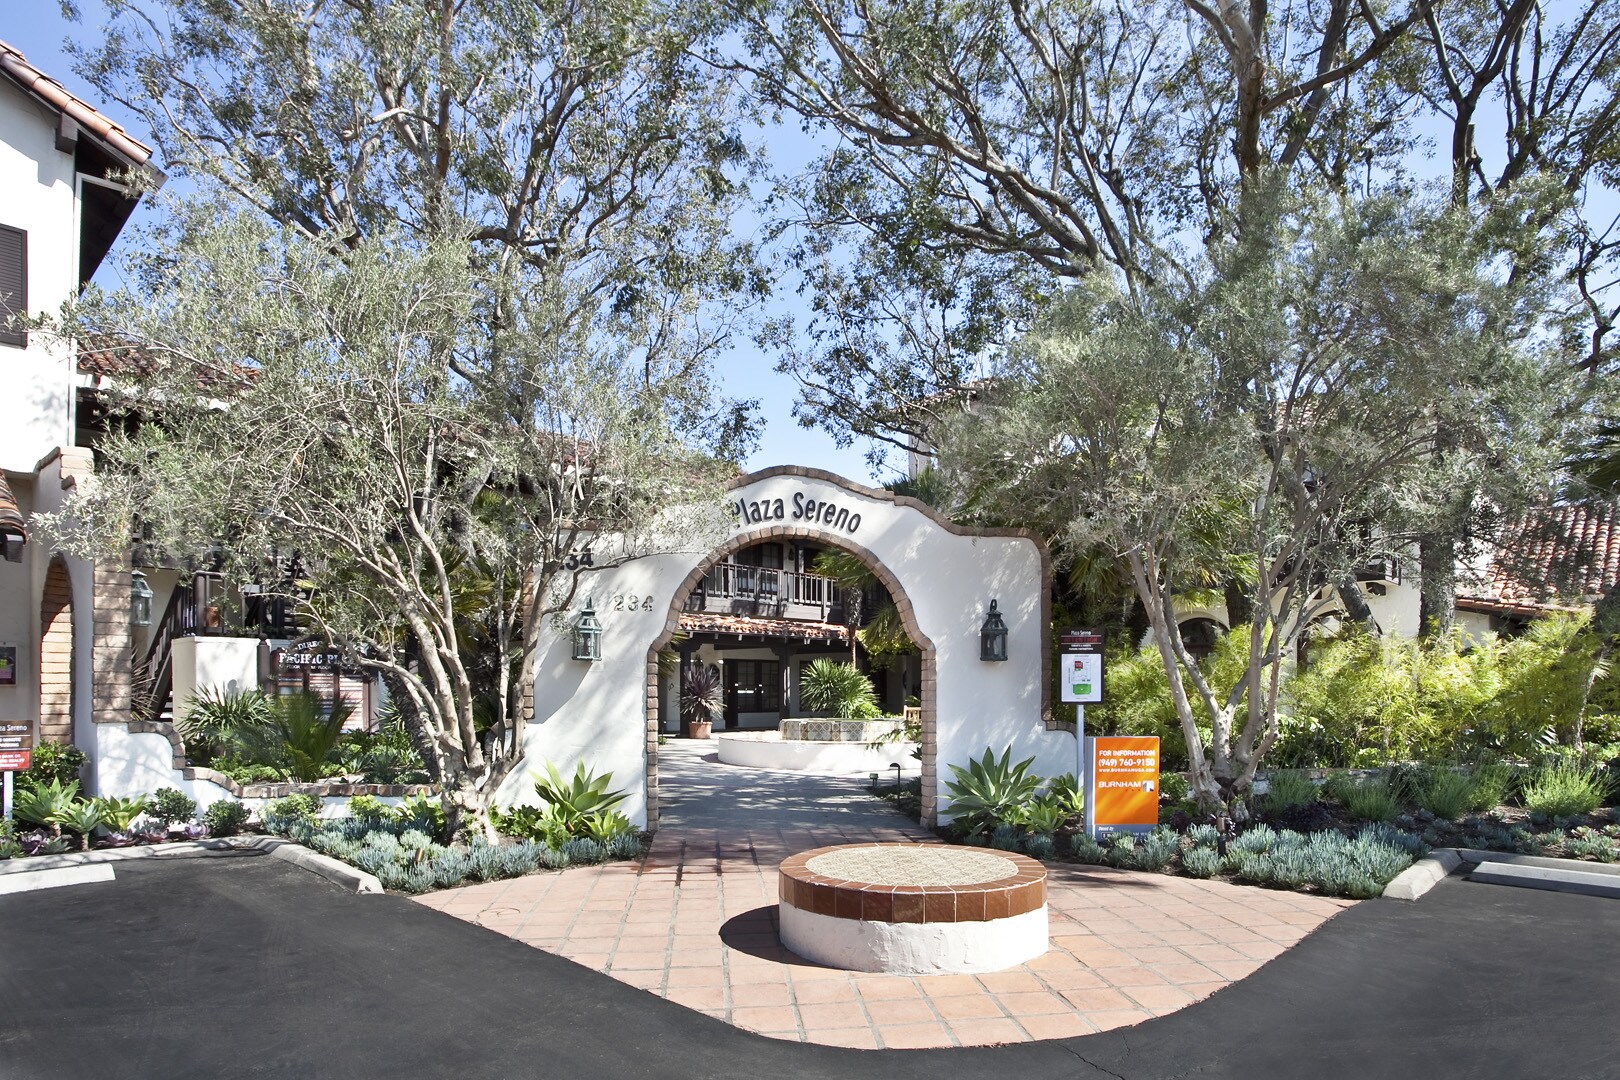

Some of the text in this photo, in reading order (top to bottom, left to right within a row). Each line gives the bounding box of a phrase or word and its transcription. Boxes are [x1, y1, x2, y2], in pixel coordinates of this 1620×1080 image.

[791, 491, 862, 534] Sereno
[613, 594, 655, 612] 234
[1098, 749, 1156, 757] FOR INFORMATION
[1098, 758, 1156, 767] (949) 760-9150
